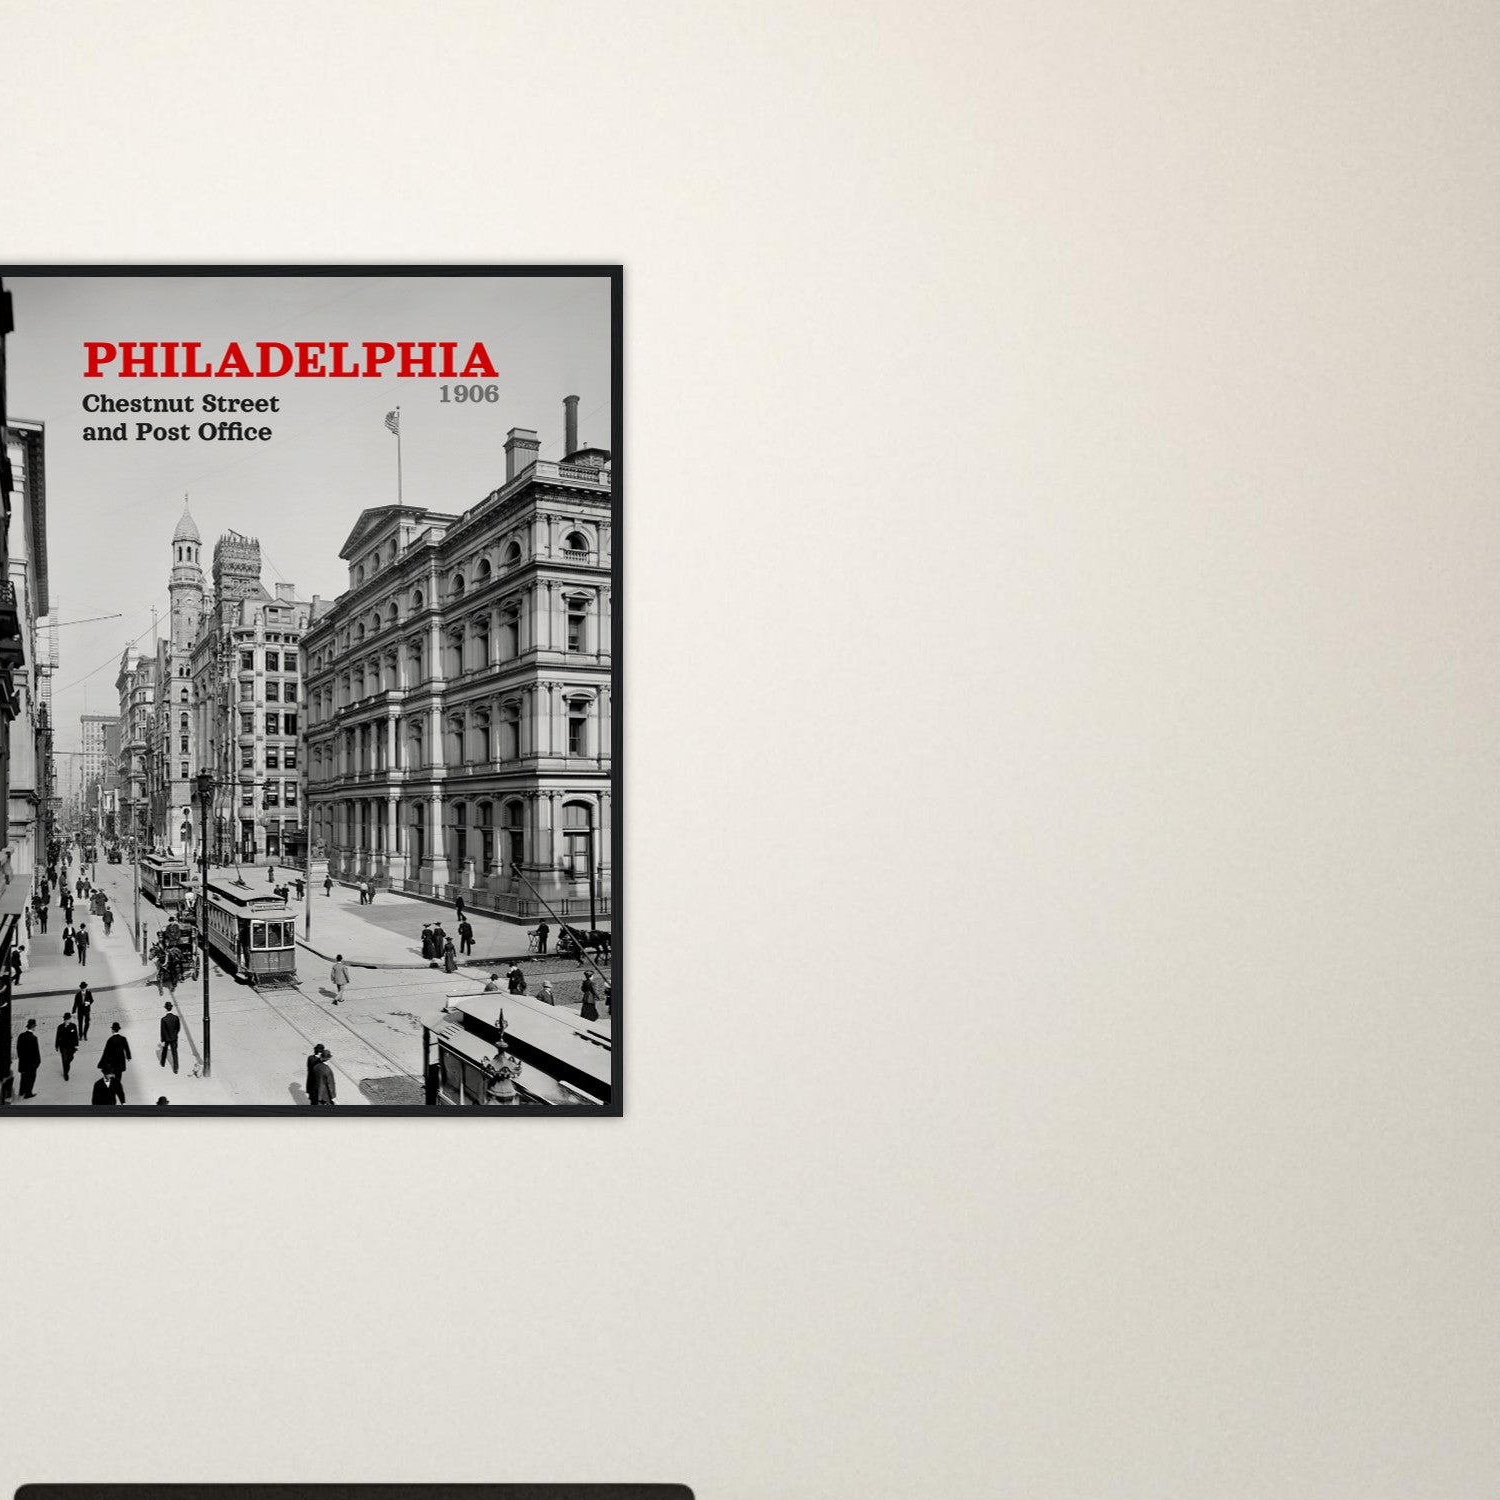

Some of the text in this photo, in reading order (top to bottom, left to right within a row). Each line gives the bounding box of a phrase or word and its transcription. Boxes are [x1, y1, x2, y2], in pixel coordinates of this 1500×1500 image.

[83, 341, 500, 379] PHILADELPHIA
[82, 393, 280, 413] Chestnut Street
[439, 384, 500, 404] 1906
[82, 421, 273, 442] and Post Office
